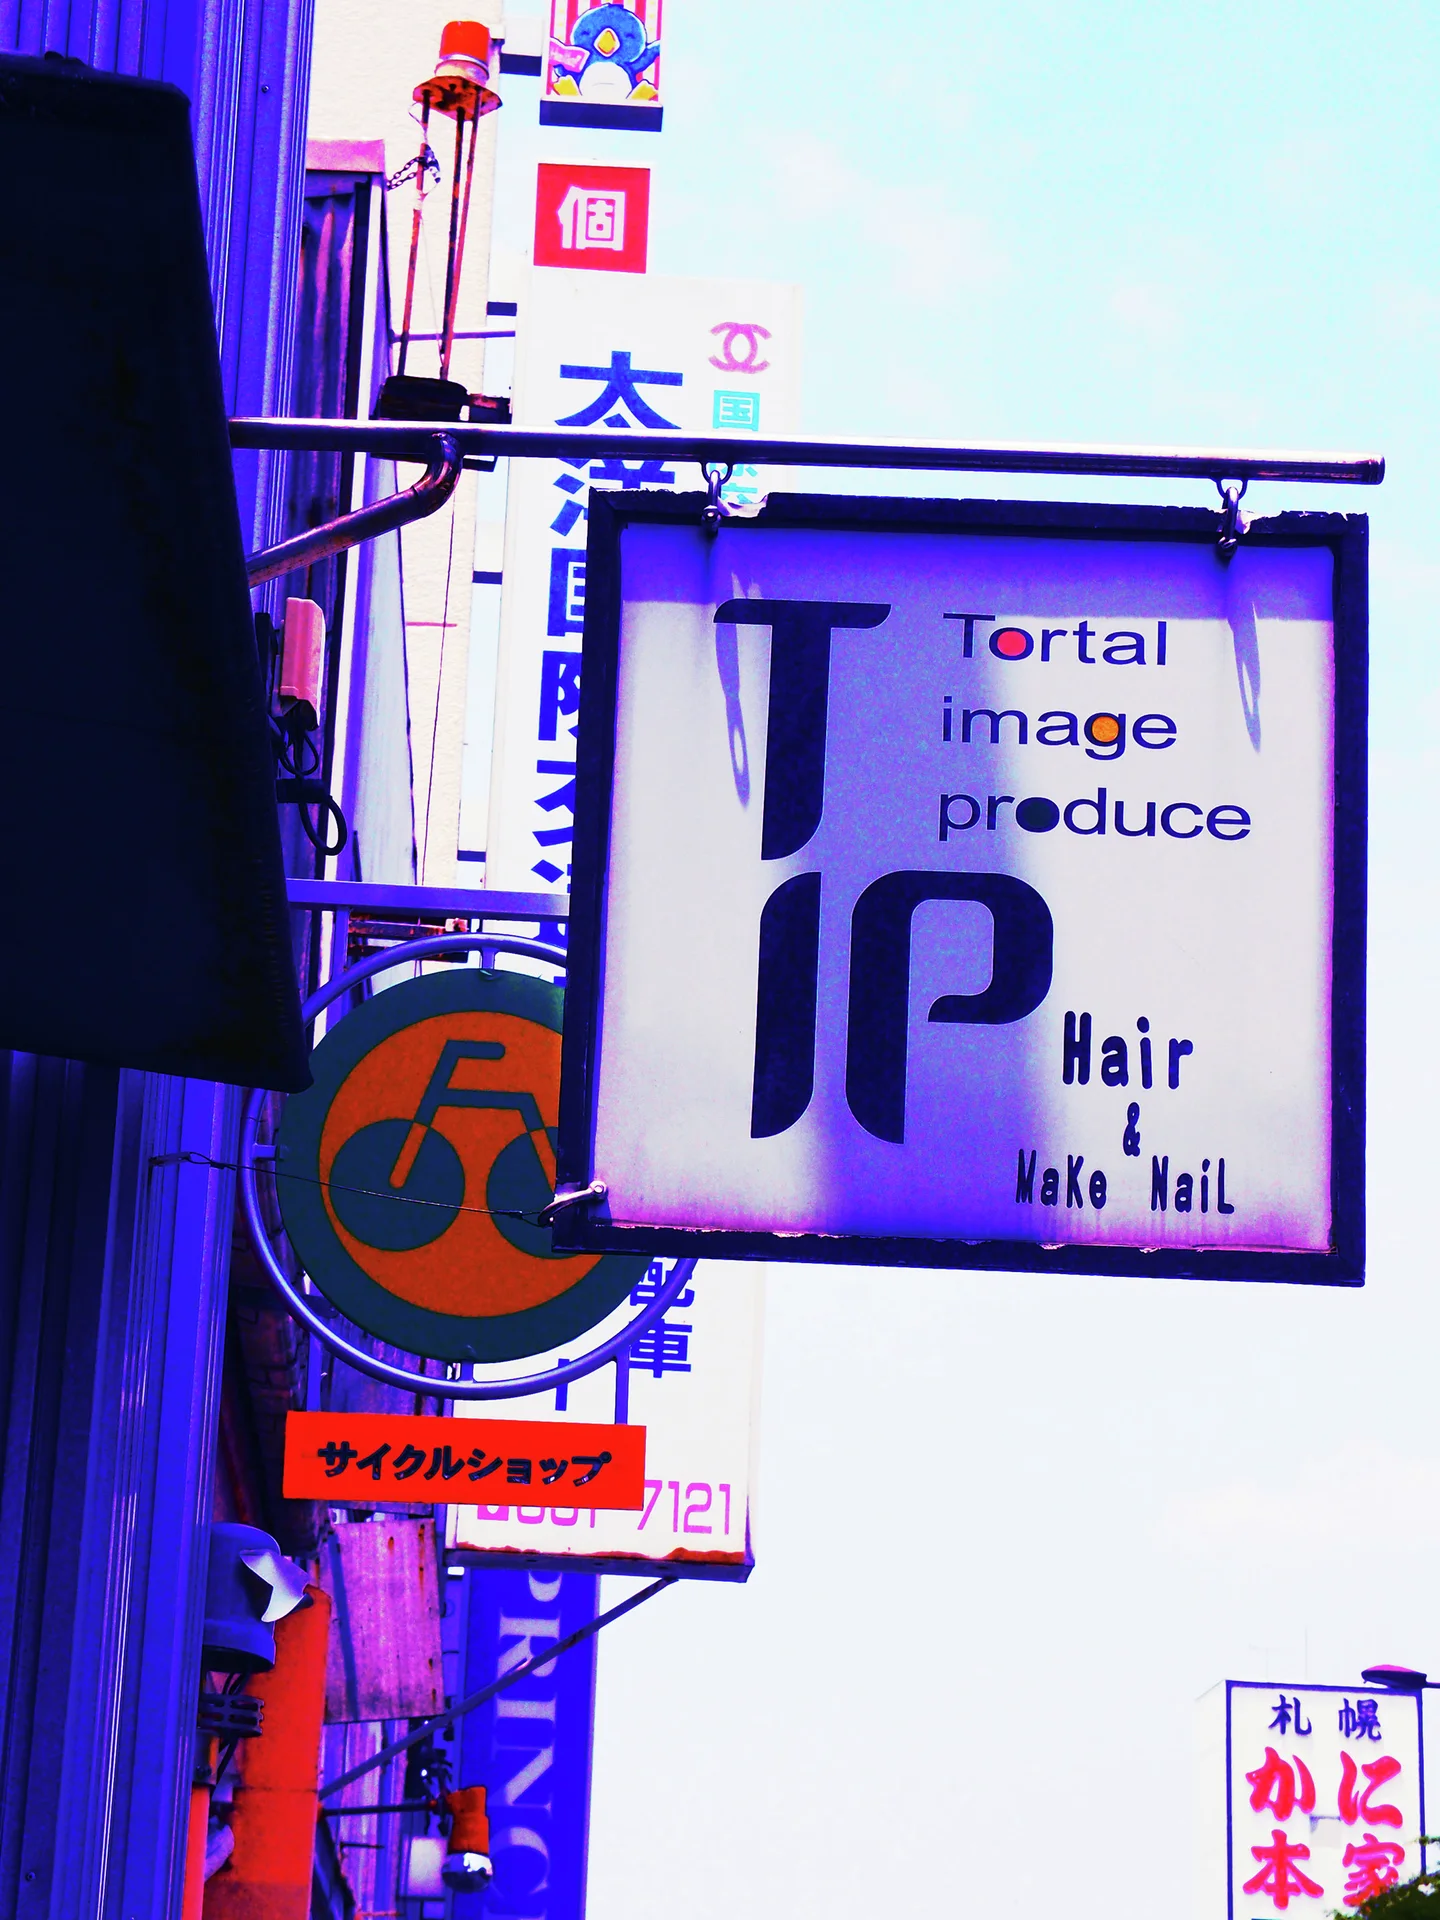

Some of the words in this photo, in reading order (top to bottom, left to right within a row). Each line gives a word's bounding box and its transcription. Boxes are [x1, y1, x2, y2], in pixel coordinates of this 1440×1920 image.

[557, 185, 626, 251] 個
[942, 612, 1168, 666] Tortal
[942, 695, 1178, 761] image
[938, 787, 1252, 842] produce
[1062, 1010, 1194, 1090] Hair
[1122, 1101, 1141, 1157] &
[317, 1441, 613, 1488] サイクルショップ
[1268, 1694, 1383, 1741] 札幌
[1245, 1746, 1403, 1829] かに
[1242, 1829, 1406, 1911] 本家
